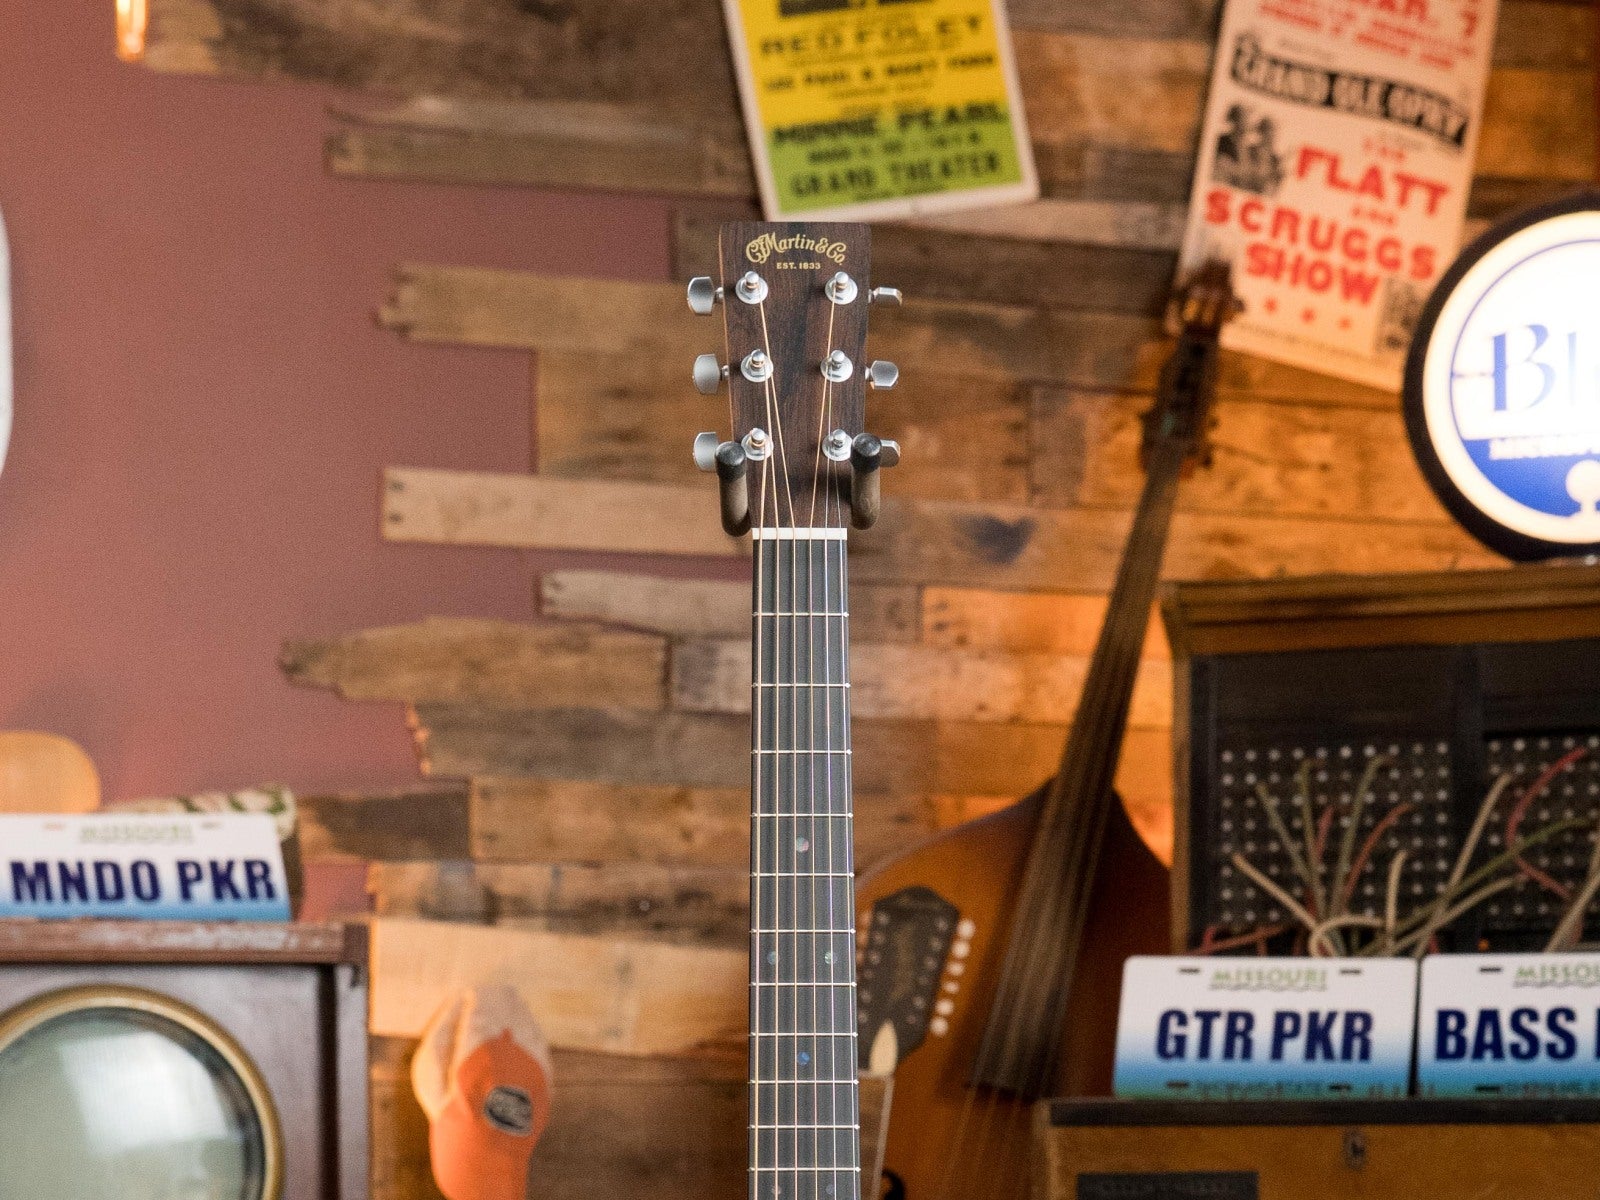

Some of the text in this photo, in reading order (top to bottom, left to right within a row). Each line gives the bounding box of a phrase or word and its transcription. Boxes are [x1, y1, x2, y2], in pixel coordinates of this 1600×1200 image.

[898, 102, 1005, 131] PEARL
[1236, 44, 1466, 148] GRAND OLE OPRY
[793, 167, 877, 197] GRAND
[889, 152, 999, 181] THEATER
[1297, 147, 1448, 216] FLATT
[1206, 188, 1435, 280] SCRUGGS
[799, 262, 821, 270] 1833
[1246, 243, 1380, 308] SHOW
[9, 858, 277, 903] MNDO PKR
[1210, 967, 1327, 989] MISSOURI
[1156, 1008, 1374, 1063] GTR PKR
[1436, 1007, 1577, 1061] BASS
